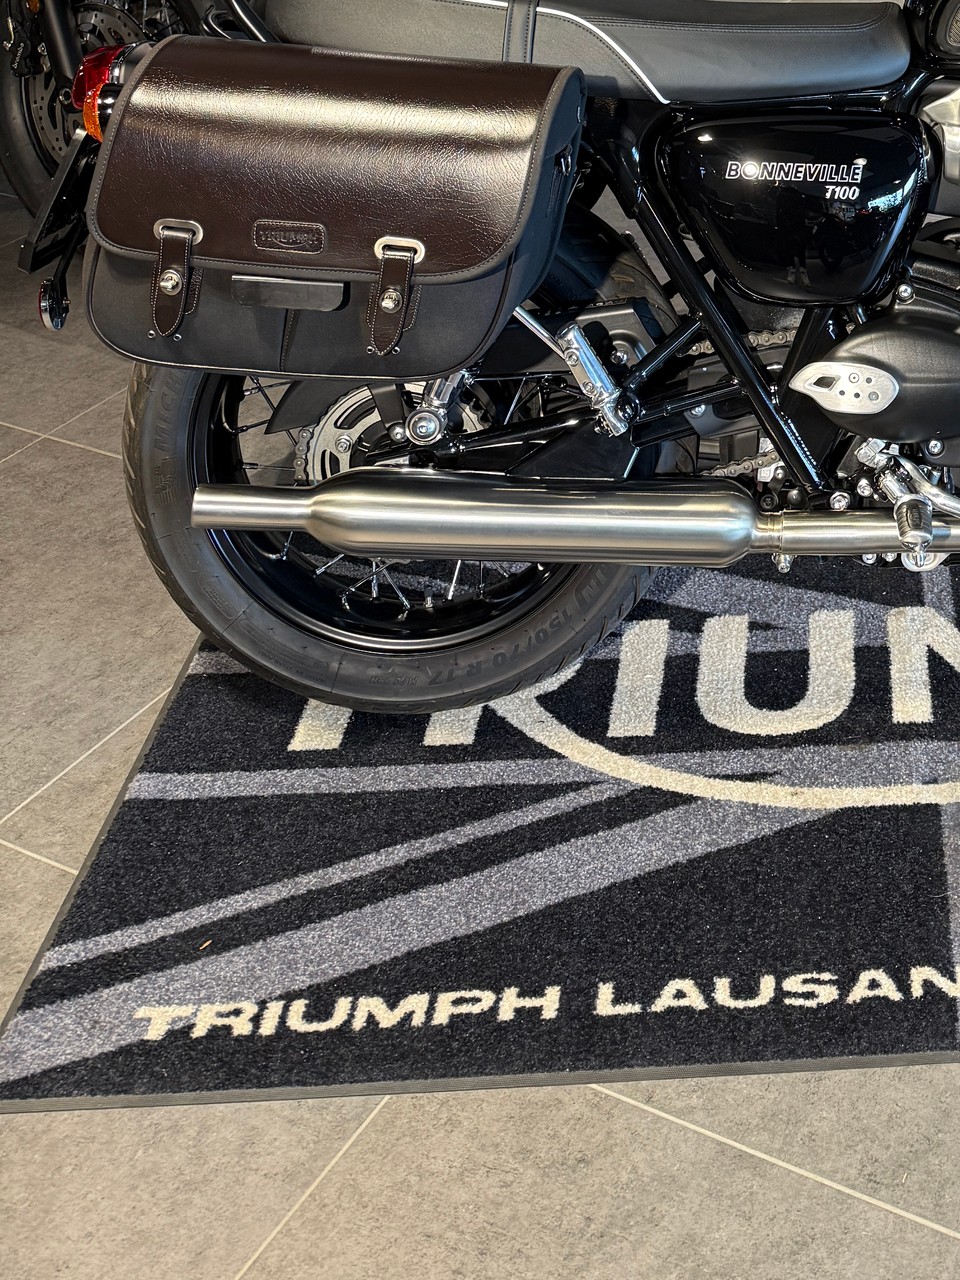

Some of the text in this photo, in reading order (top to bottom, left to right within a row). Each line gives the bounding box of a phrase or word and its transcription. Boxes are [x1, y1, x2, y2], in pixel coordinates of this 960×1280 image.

[725, 161, 864, 183] BONNEVILLE
[824, 185, 860, 201] T100
[134, 985, 562, 1043] TRIUMPH
